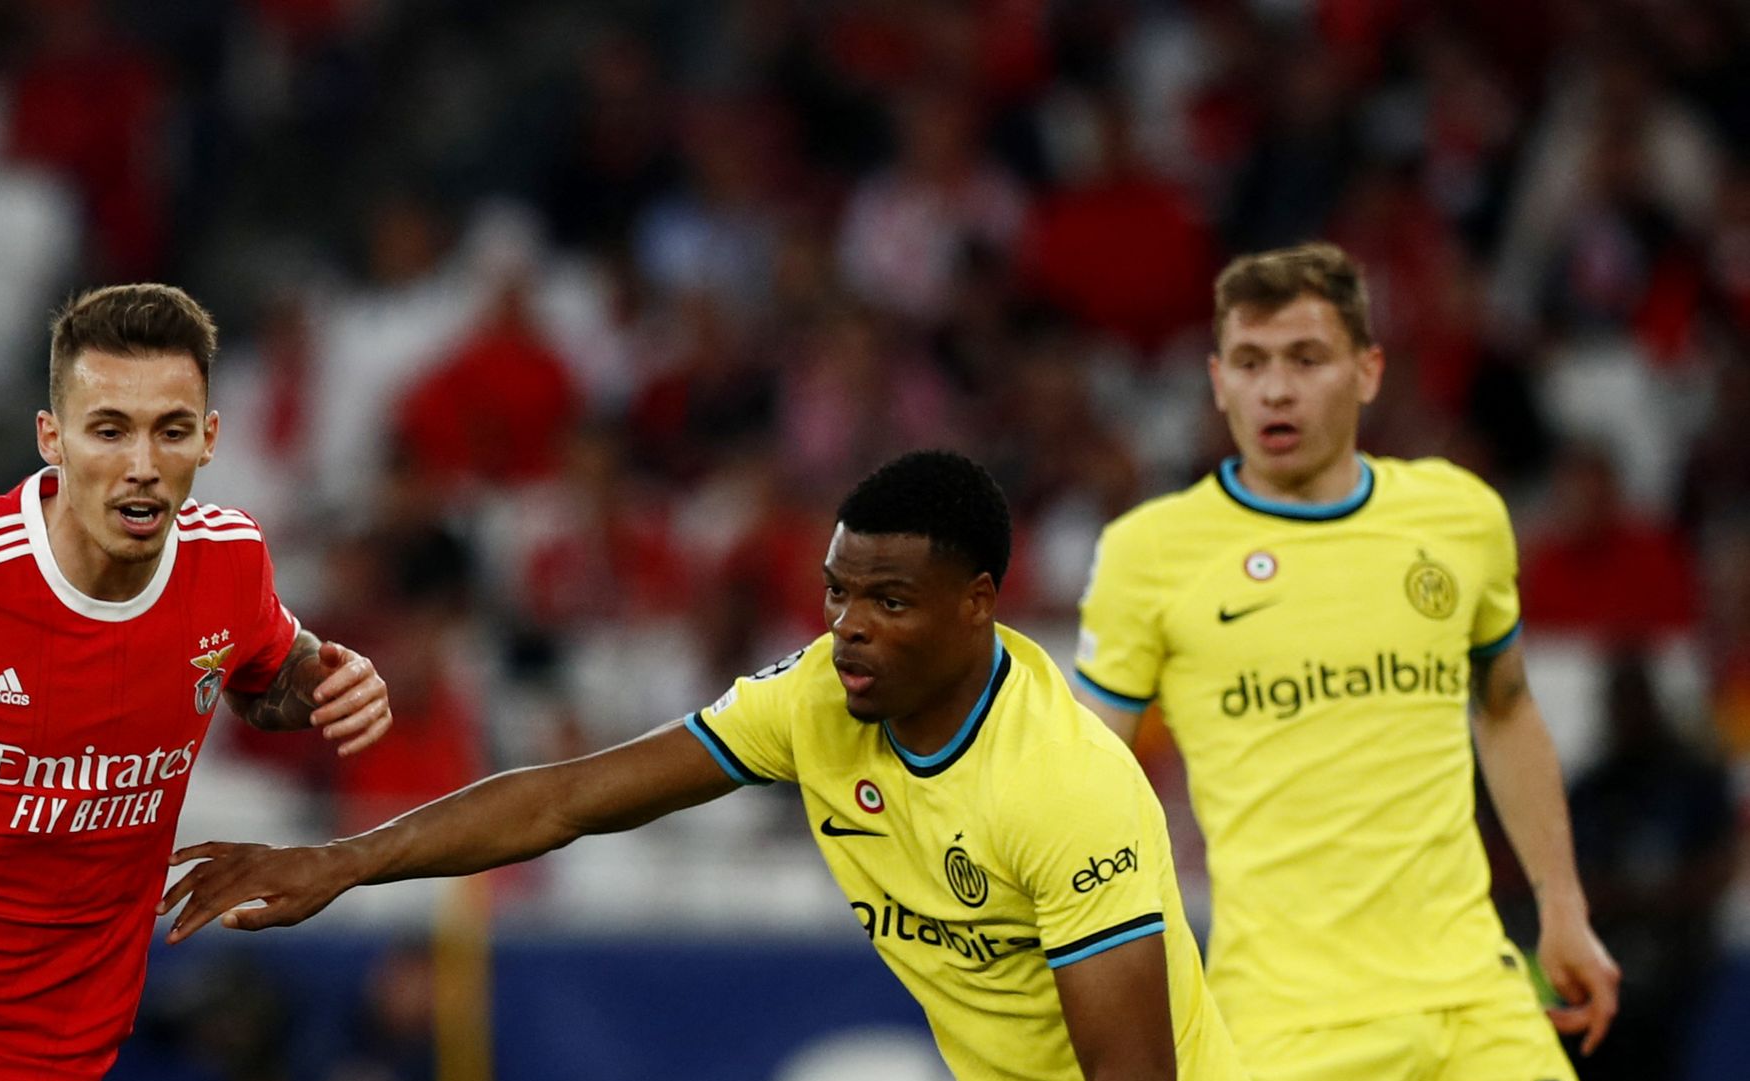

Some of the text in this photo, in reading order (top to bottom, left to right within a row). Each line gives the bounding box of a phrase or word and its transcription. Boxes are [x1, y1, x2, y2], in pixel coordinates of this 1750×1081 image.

[1220, 652, 1461, 720] digitalbits
[10, 789, 164, 834] FLY BETTER
[1072, 840, 1139, 894] ebay
